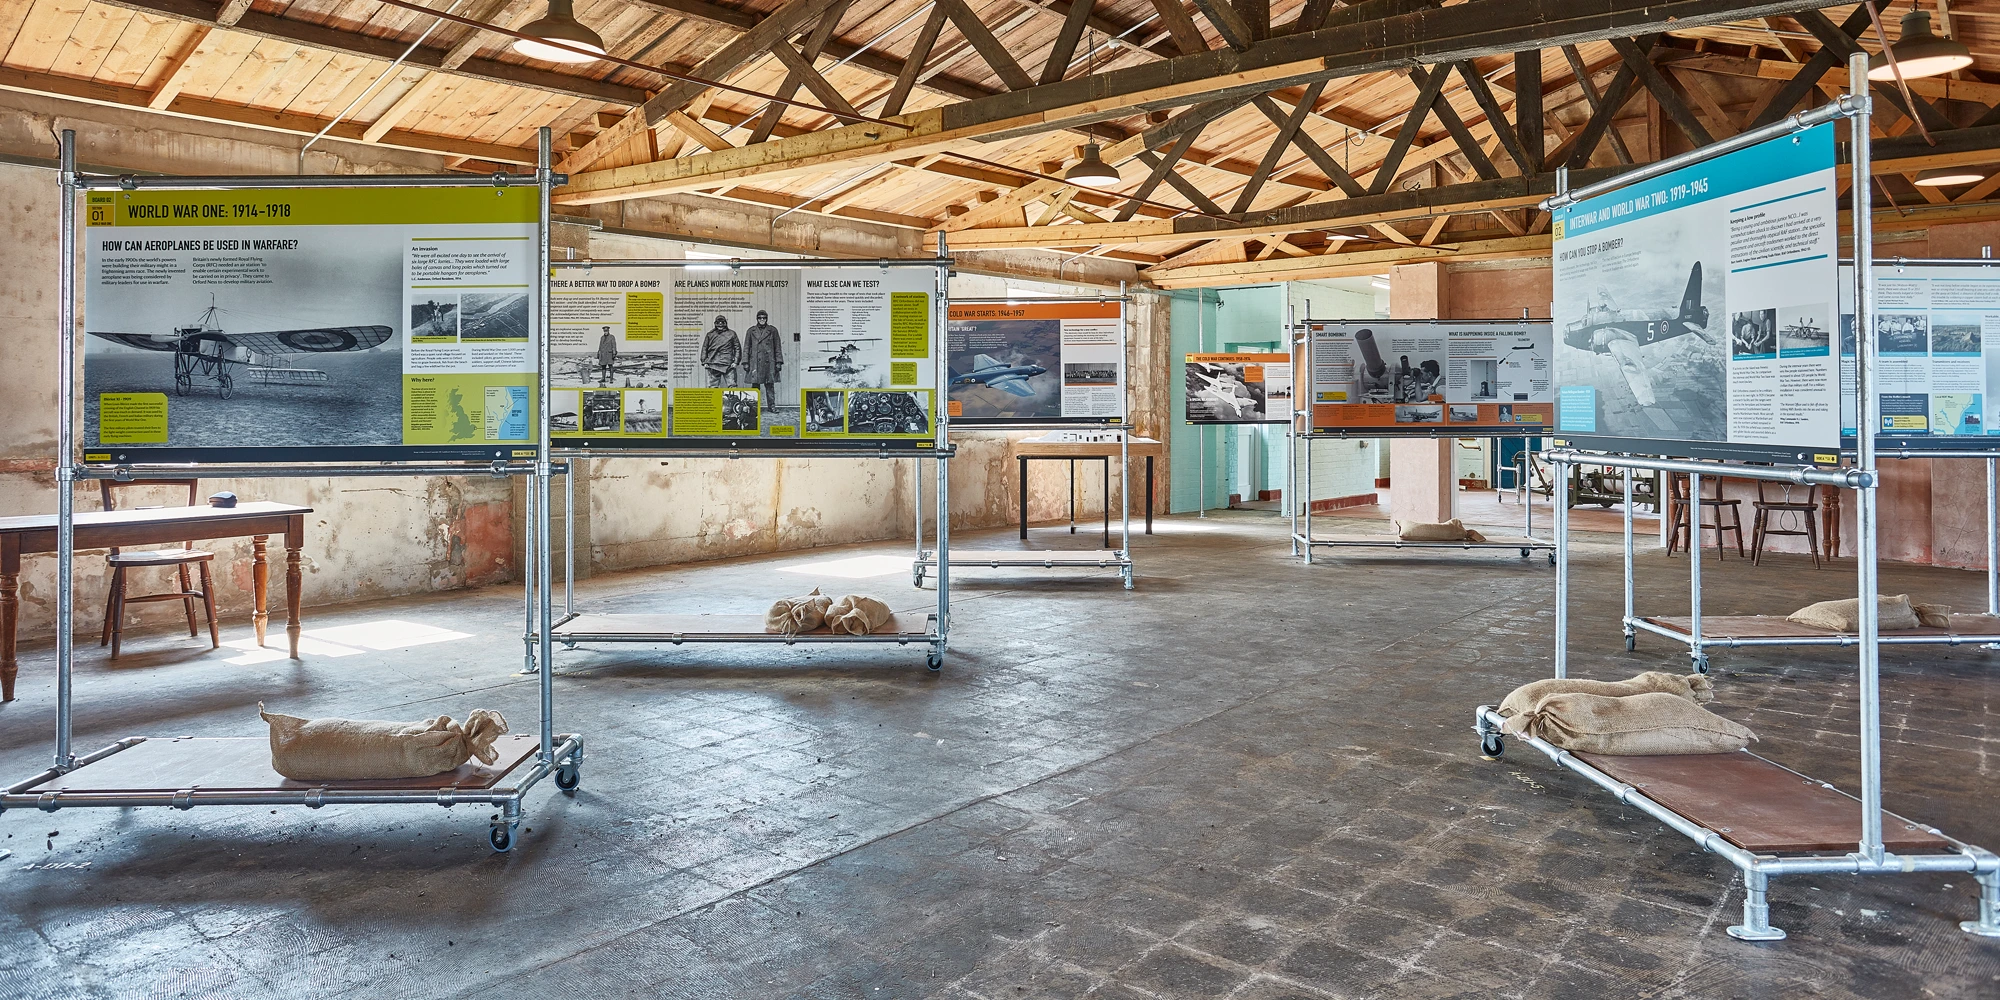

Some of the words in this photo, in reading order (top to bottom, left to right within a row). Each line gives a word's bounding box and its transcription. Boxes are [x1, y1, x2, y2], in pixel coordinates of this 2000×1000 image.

[92, 211, 103, 220] 01
[128, 205, 168, 218] WORLD
[173, 205, 198, 218] WAR
[203, 204, 228, 218] ONE:
[1570, 212, 1597, 230] INTERWAR
[1598, 207, 1610, 222] AND
[1612, 202, 1634, 218] WORLD
[1635, 196, 1649, 212] WAR
[1651, 191, 1668, 207] TWO:
[1555, 227, 1561, 236] 02
[102, 241, 122, 251] HOW
[125, 241, 142, 251] CAN
[145, 240, 200, 251] AEROPLANES
[203, 240, 214, 250] BE
[217, 240, 238, 250] USED
[242, 240, 250, 250] IN
[253, 240, 298, 250] WARFARE?
[1560, 251, 1568, 261] HOW
[1569, 249, 1577, 259] CAN
[1578, 247, 1586, 257] YOU
[1587, 244, 1597, 255] STOP
[1598, 243, 1601, 252] A
[1602, 238, 1623, 251] BOMBER?
[1647, 323, 1654, 341] 5
